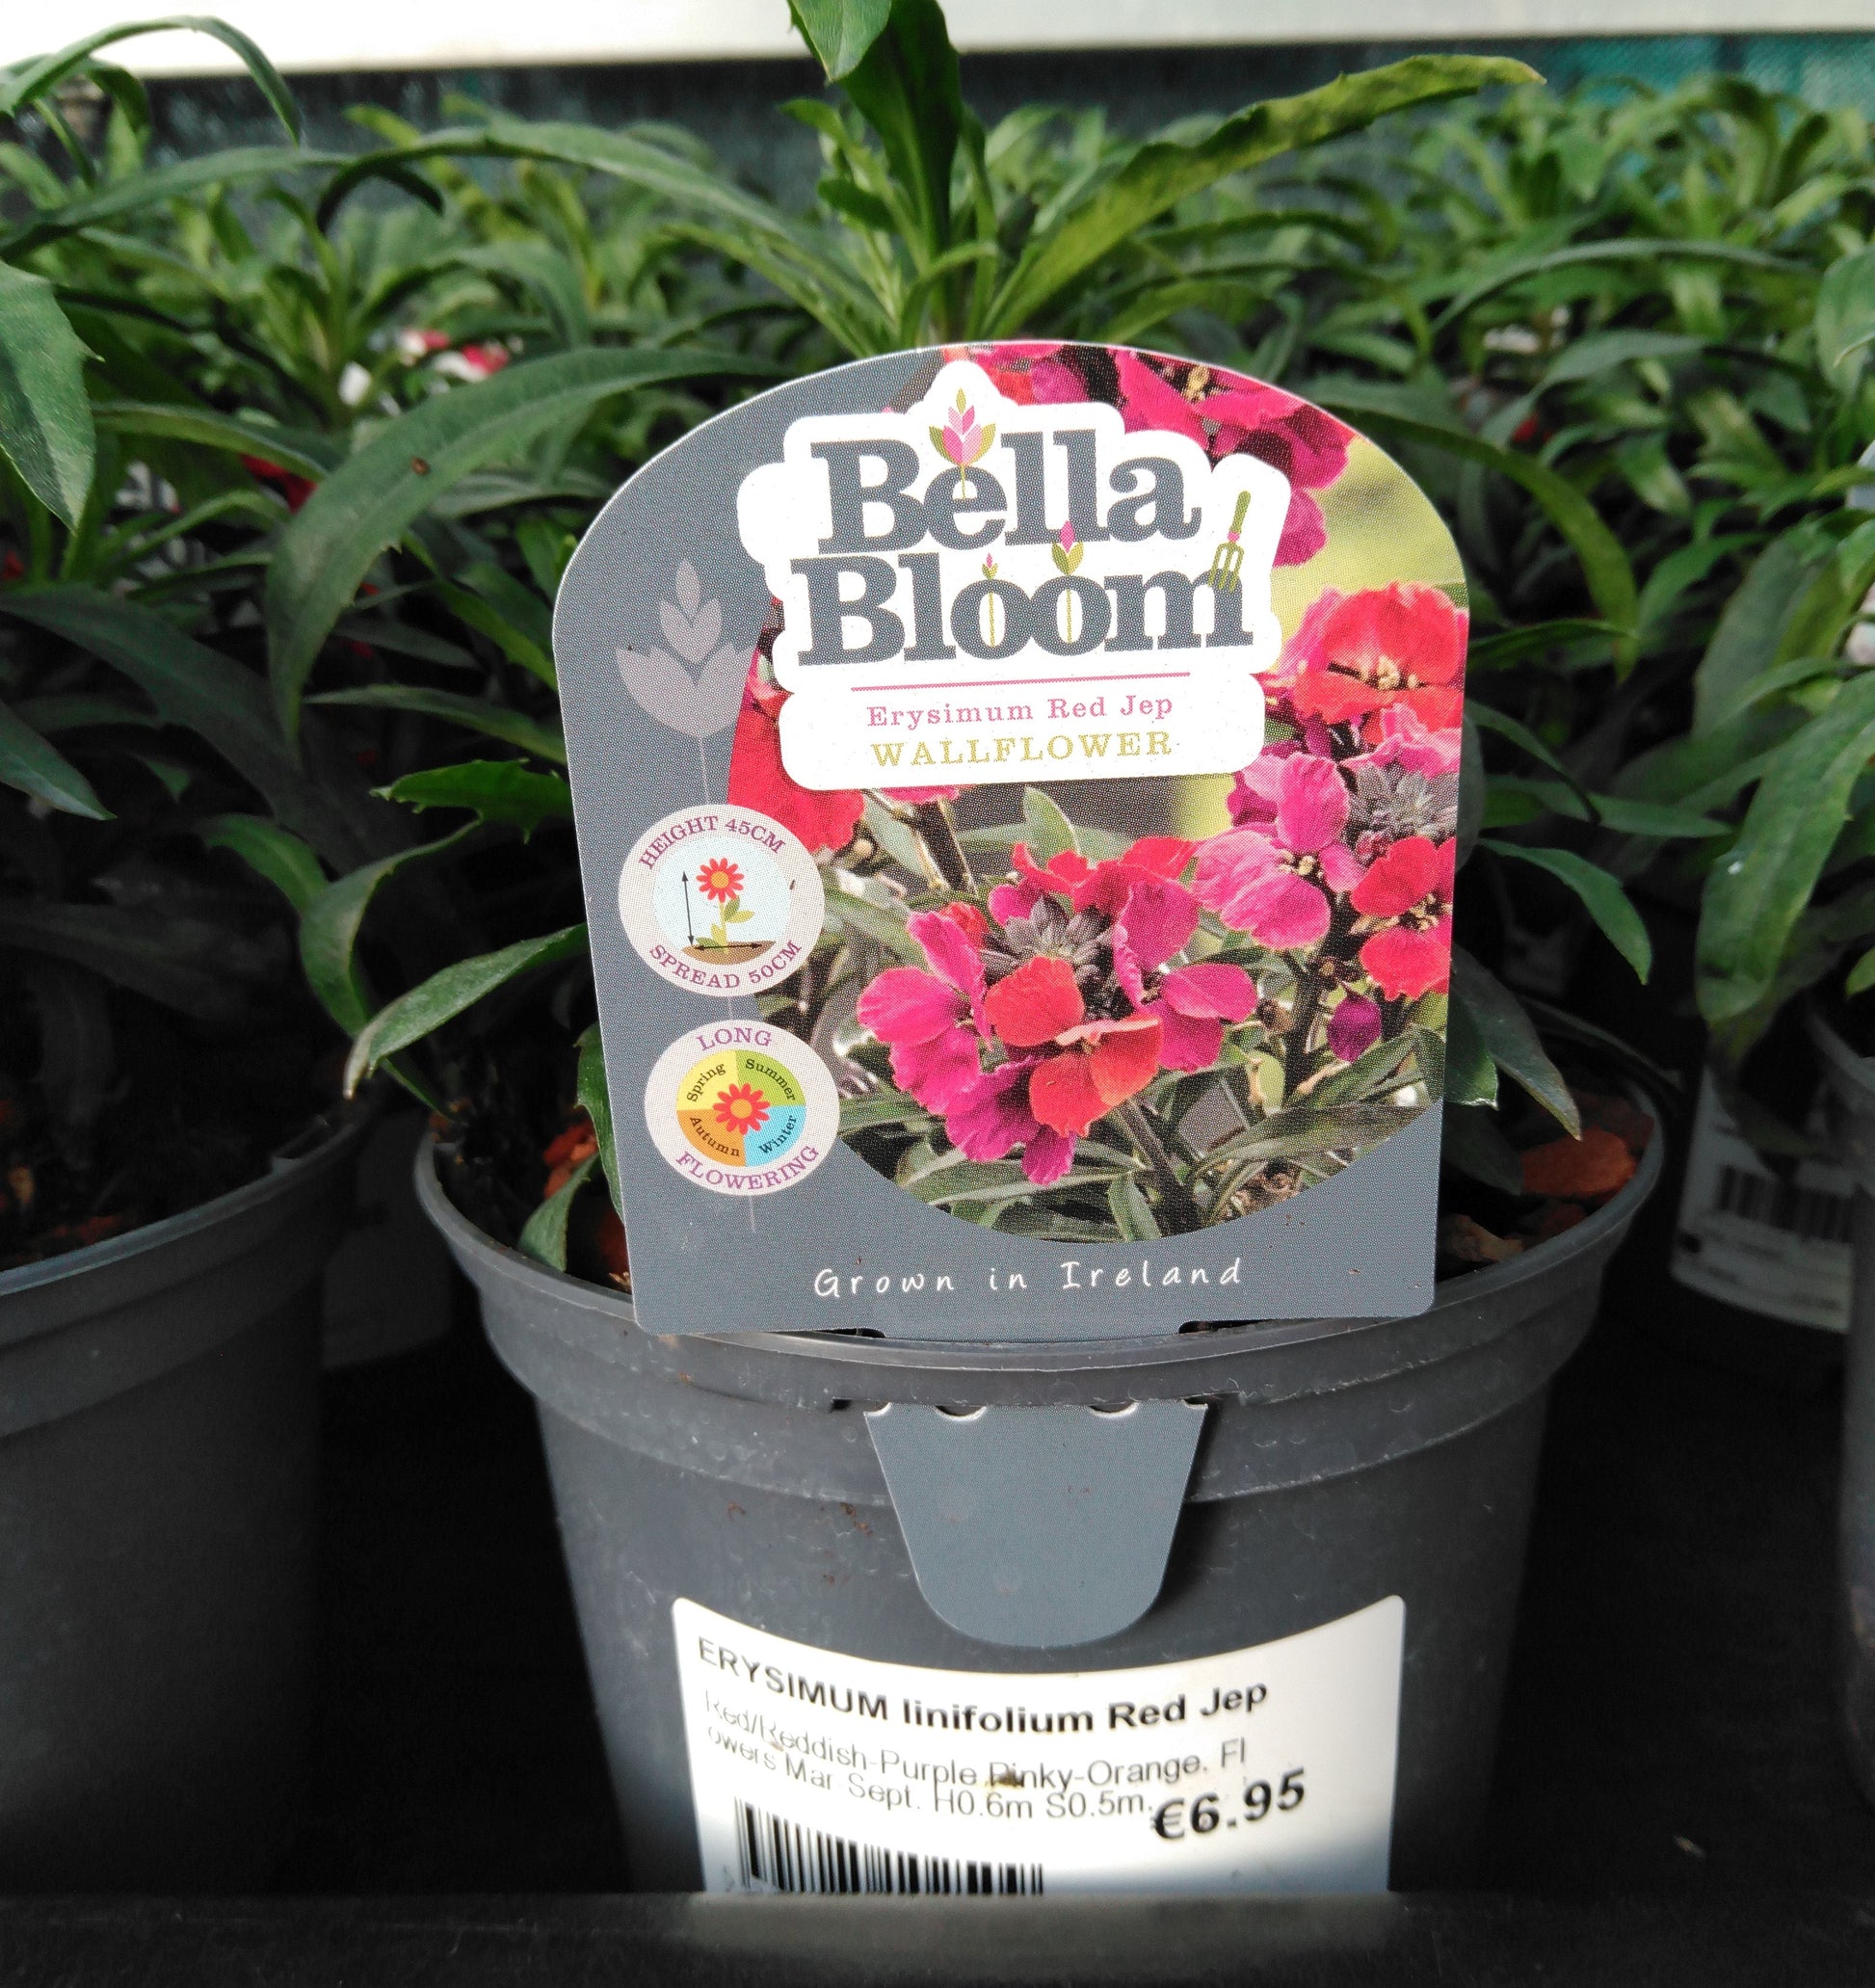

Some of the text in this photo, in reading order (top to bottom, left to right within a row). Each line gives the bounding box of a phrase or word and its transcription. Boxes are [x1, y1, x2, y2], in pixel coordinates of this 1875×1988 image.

[810, 429, 1202, 554] Bella
[790, 551, 1254, 666] Bloom
[867, 695, 1173, 730] Erysimum Red Jep
[870, 729, 1173, 767] WALLFLOWER
[639, 815, 786, 869] HEIGHT 45CM
[649, 939, 802, 989] SPREAD 50CM
[696, 1027, 773, 1051] LONG
[687, 1063, 726, 1102] Spring
[745, 1058, 796, 1101] Summer
[690, 1116, 741, 1156] Autumn
[758, 1114, 797, 1154] Winter
[675, 1145, 819, 1190] FLOWERING
[813, 1257, 1242, 1298] Grown in Ireland
[699, 1636, 1268, 1733] ERYSIMUM linifolium Red Jep
[932, 1789, 1033, 1818] H0.6m
[1150, 1766, 1306, 1840] €6.95
